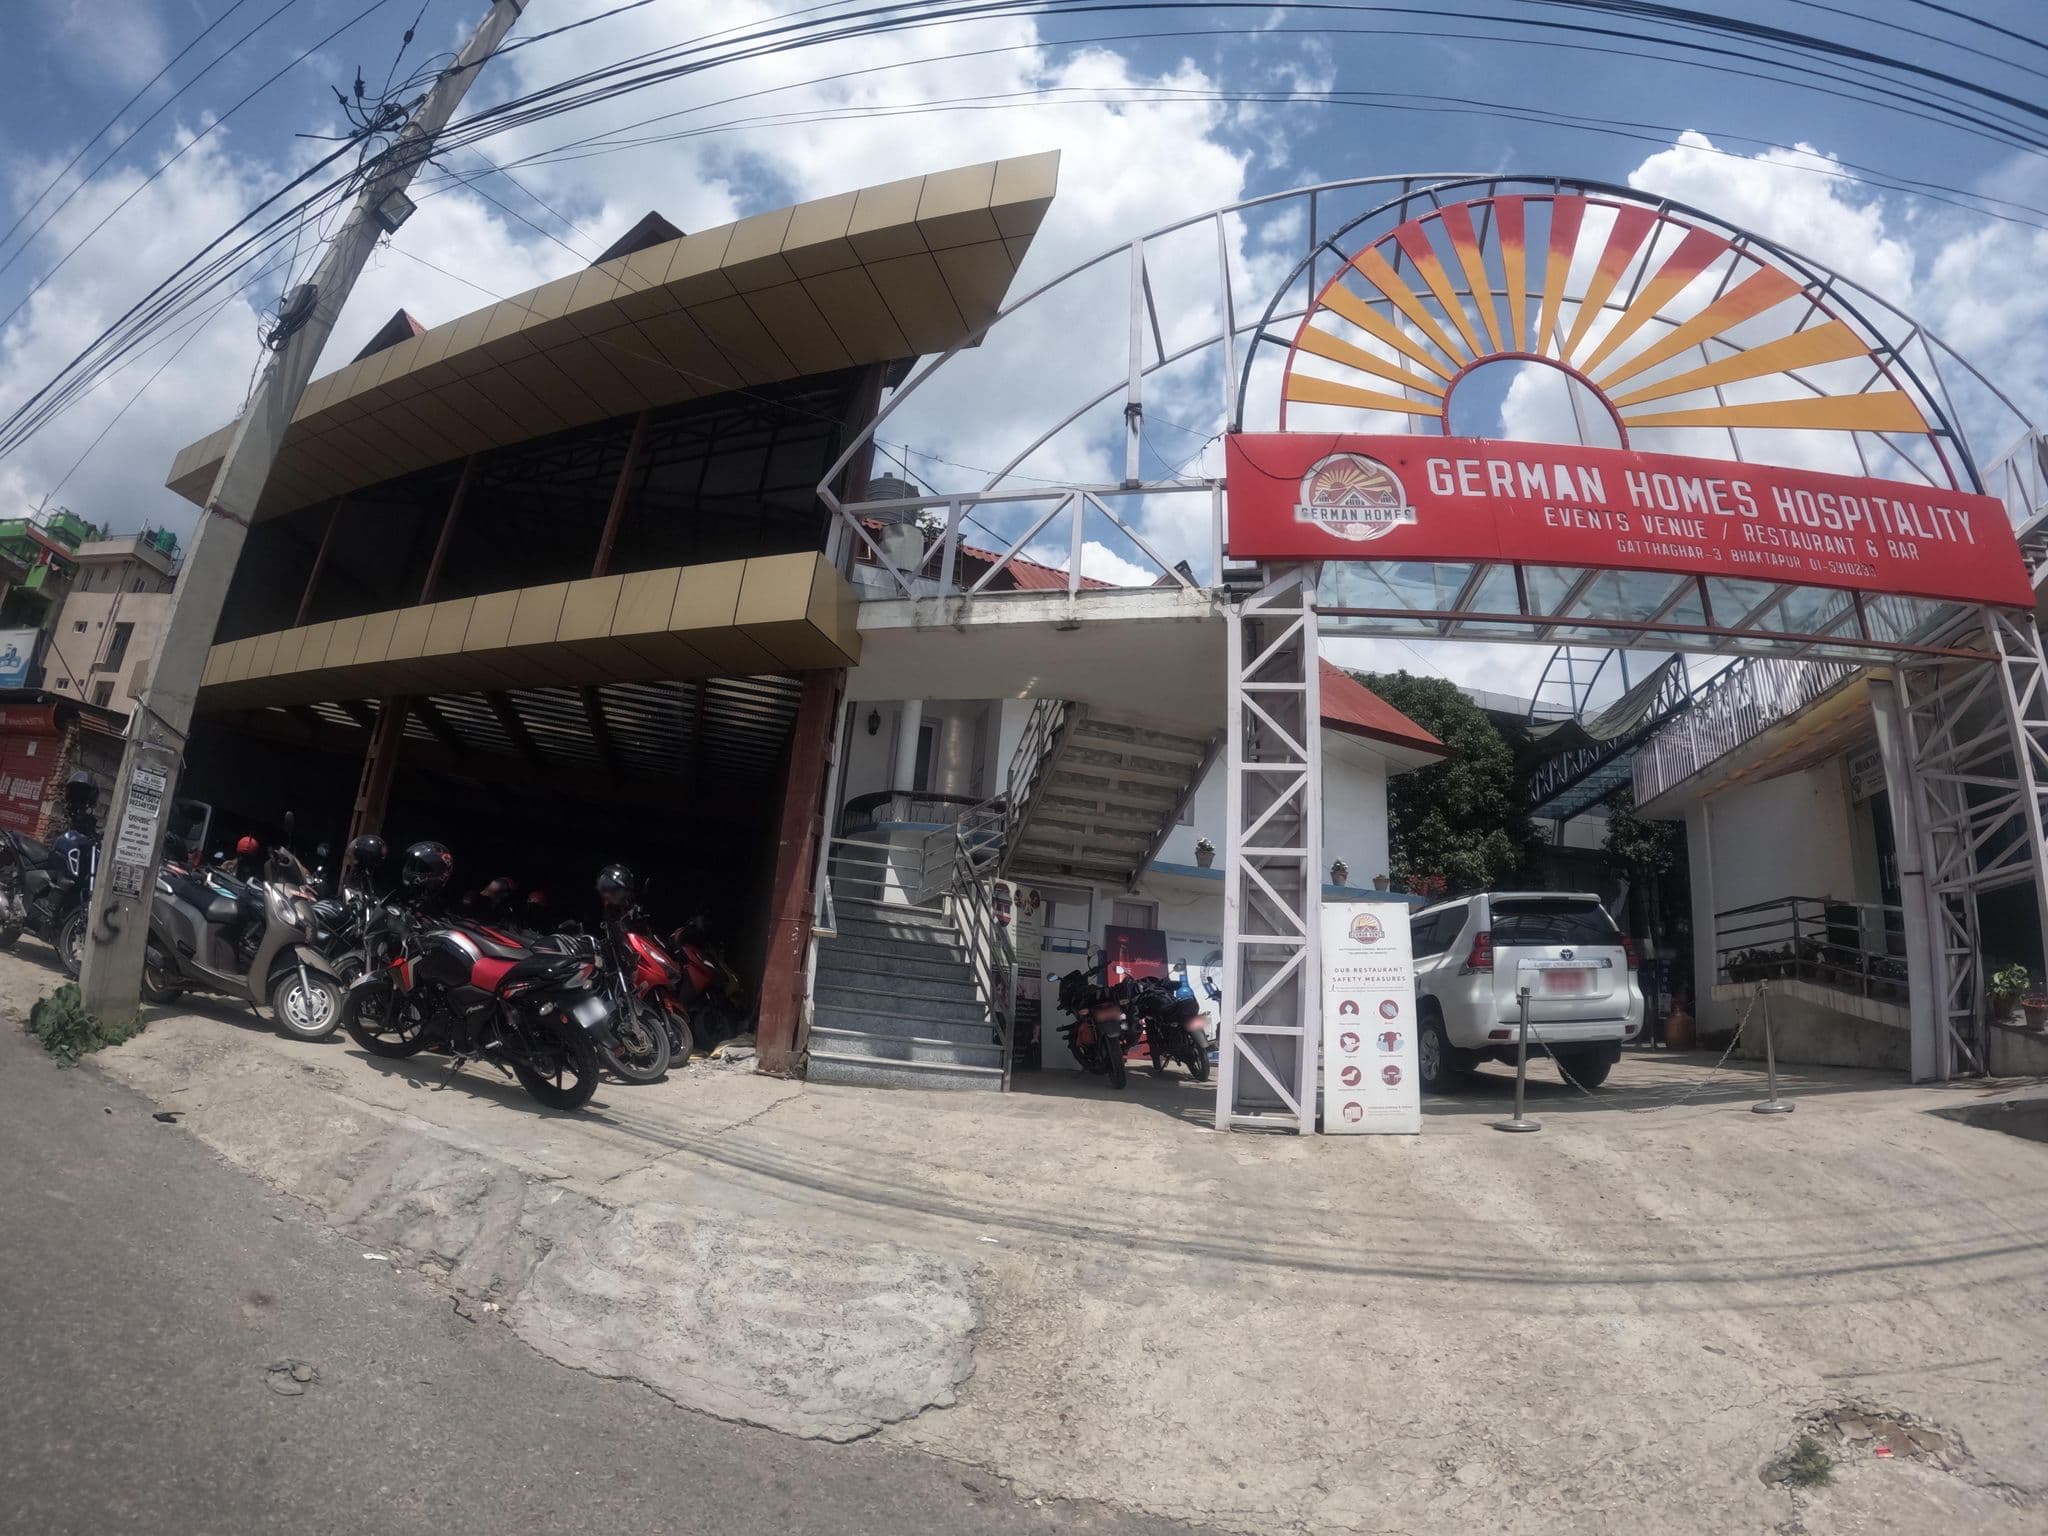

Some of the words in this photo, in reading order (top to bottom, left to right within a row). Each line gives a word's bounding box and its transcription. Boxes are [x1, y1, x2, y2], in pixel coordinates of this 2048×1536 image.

[1426, 457, 1608, 504] GERMAN
[1624, 469, 1759, 518] HOMES
[1771, 485, 1976, 545] HOSPITALITY
[1544, 506, 1631, 533] EVENTS
[1641, 514, 1708, 540] VENUE
[1722, 523, 1728, 541] /
[1743, 524, 1857, 556] RESTAURANT
[1865, 538, 1879, 558] &
[1887, 539, 1920, 561] BAR
[1617, 539, 1722, 562] GATTHAGHAR-3
[1731, 549, 1802, 569] BHAKTAPUR
[1353, 966, 1404, 974] RESTAURANT
[1365, 975, 1407, 983] MEASURES
